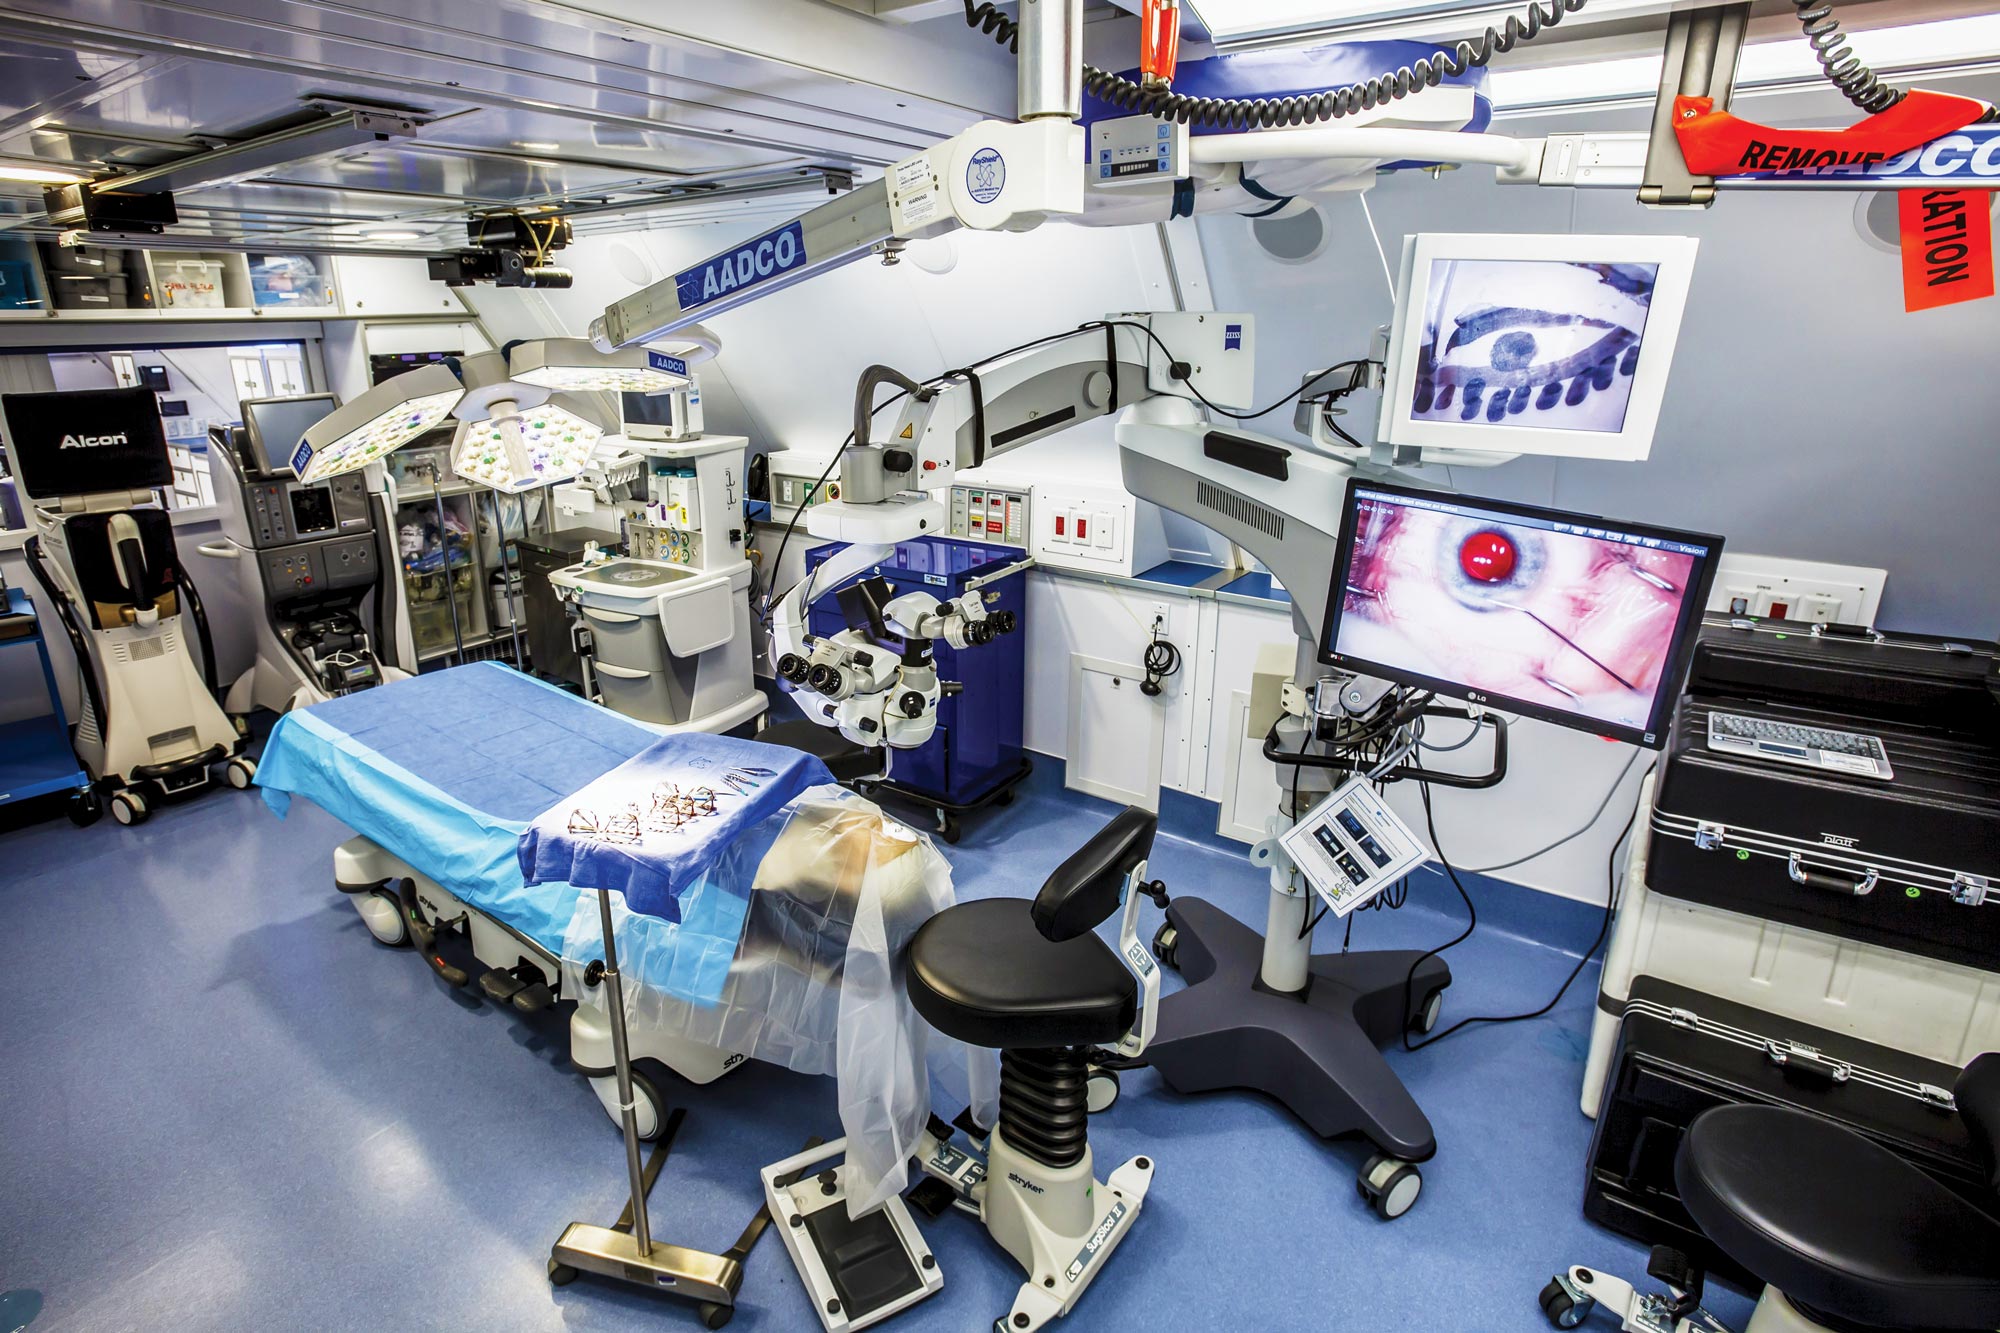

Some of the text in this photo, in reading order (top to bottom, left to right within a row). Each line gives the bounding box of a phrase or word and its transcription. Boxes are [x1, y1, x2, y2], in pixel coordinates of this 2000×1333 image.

[908, 194, 927, 204] WARNING
[703, 231, 796, 300] AADCO
[657, 357, 684, 372] AADCO
[60, 434, 128, 450] Alcon
[1008, 1172, 1045, 1194] stryker
[1086, 1214, 1116, 1253] SurgiStool
